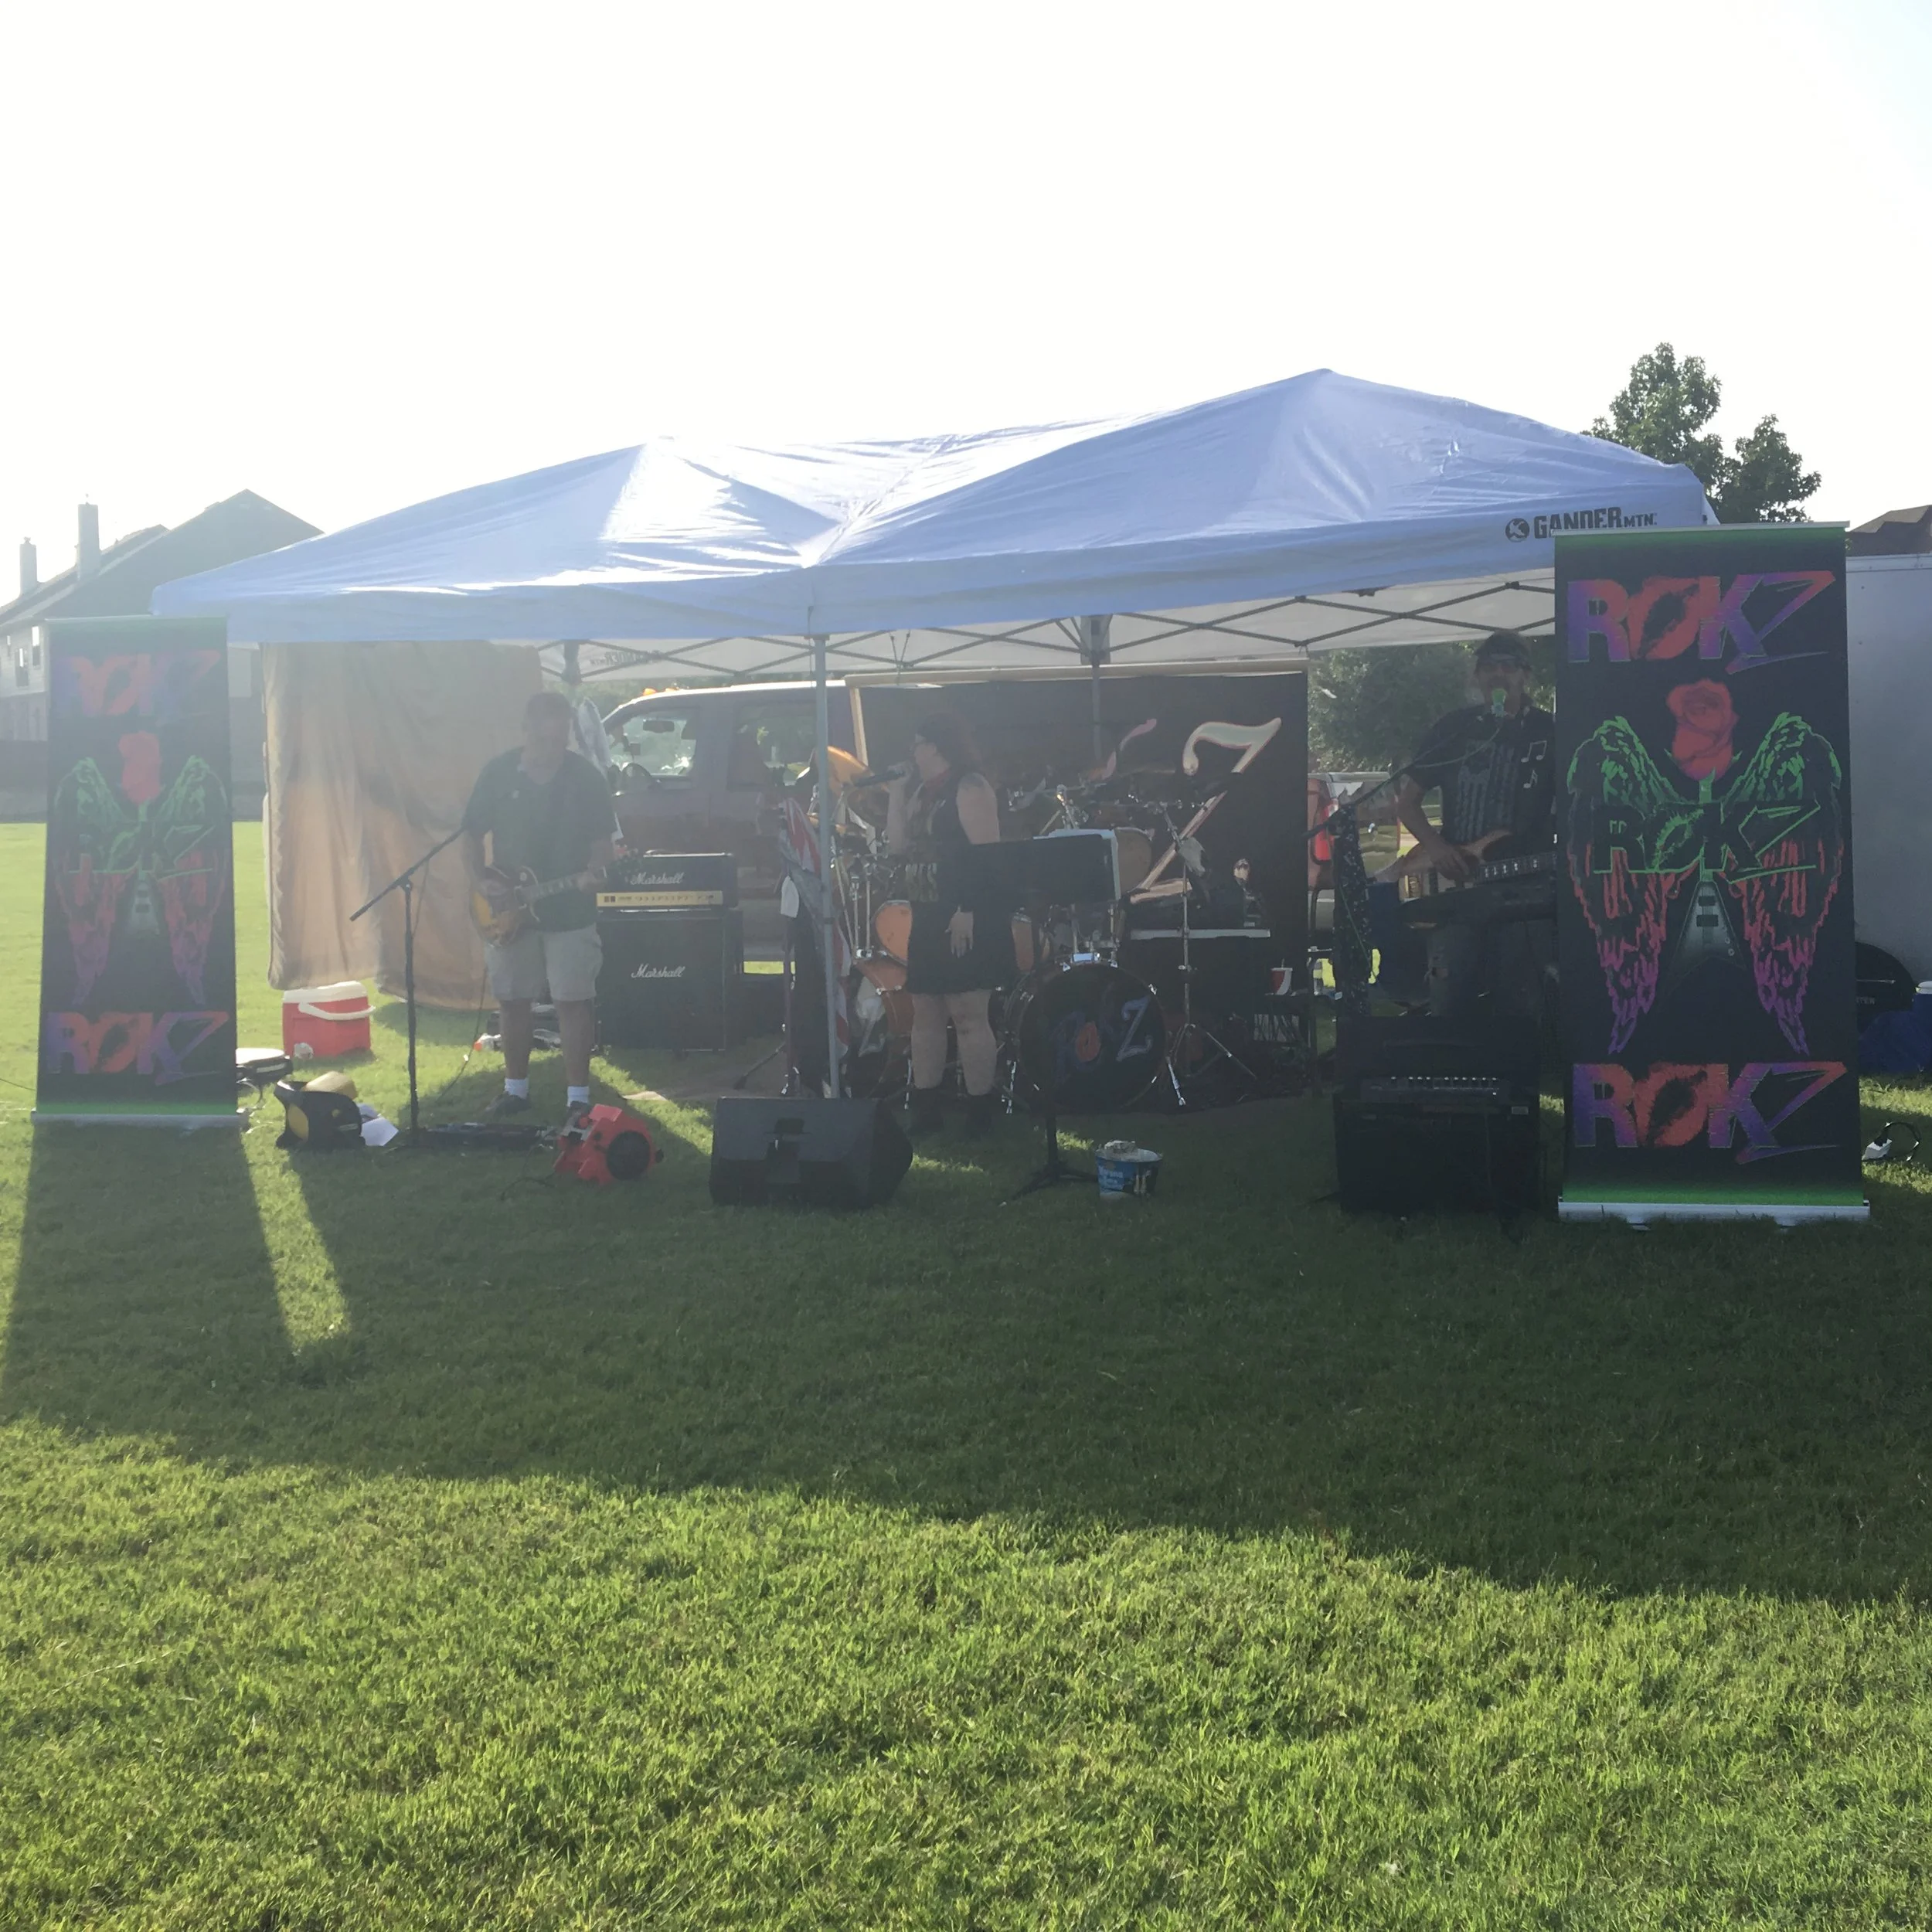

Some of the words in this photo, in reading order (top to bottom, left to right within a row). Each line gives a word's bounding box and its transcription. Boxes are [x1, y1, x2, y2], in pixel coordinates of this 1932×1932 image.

[1533, 507, 1624, 539] GANDER
[631, 871, 685, 886] Marshall
[631, 963, 685, 978] Marshall
